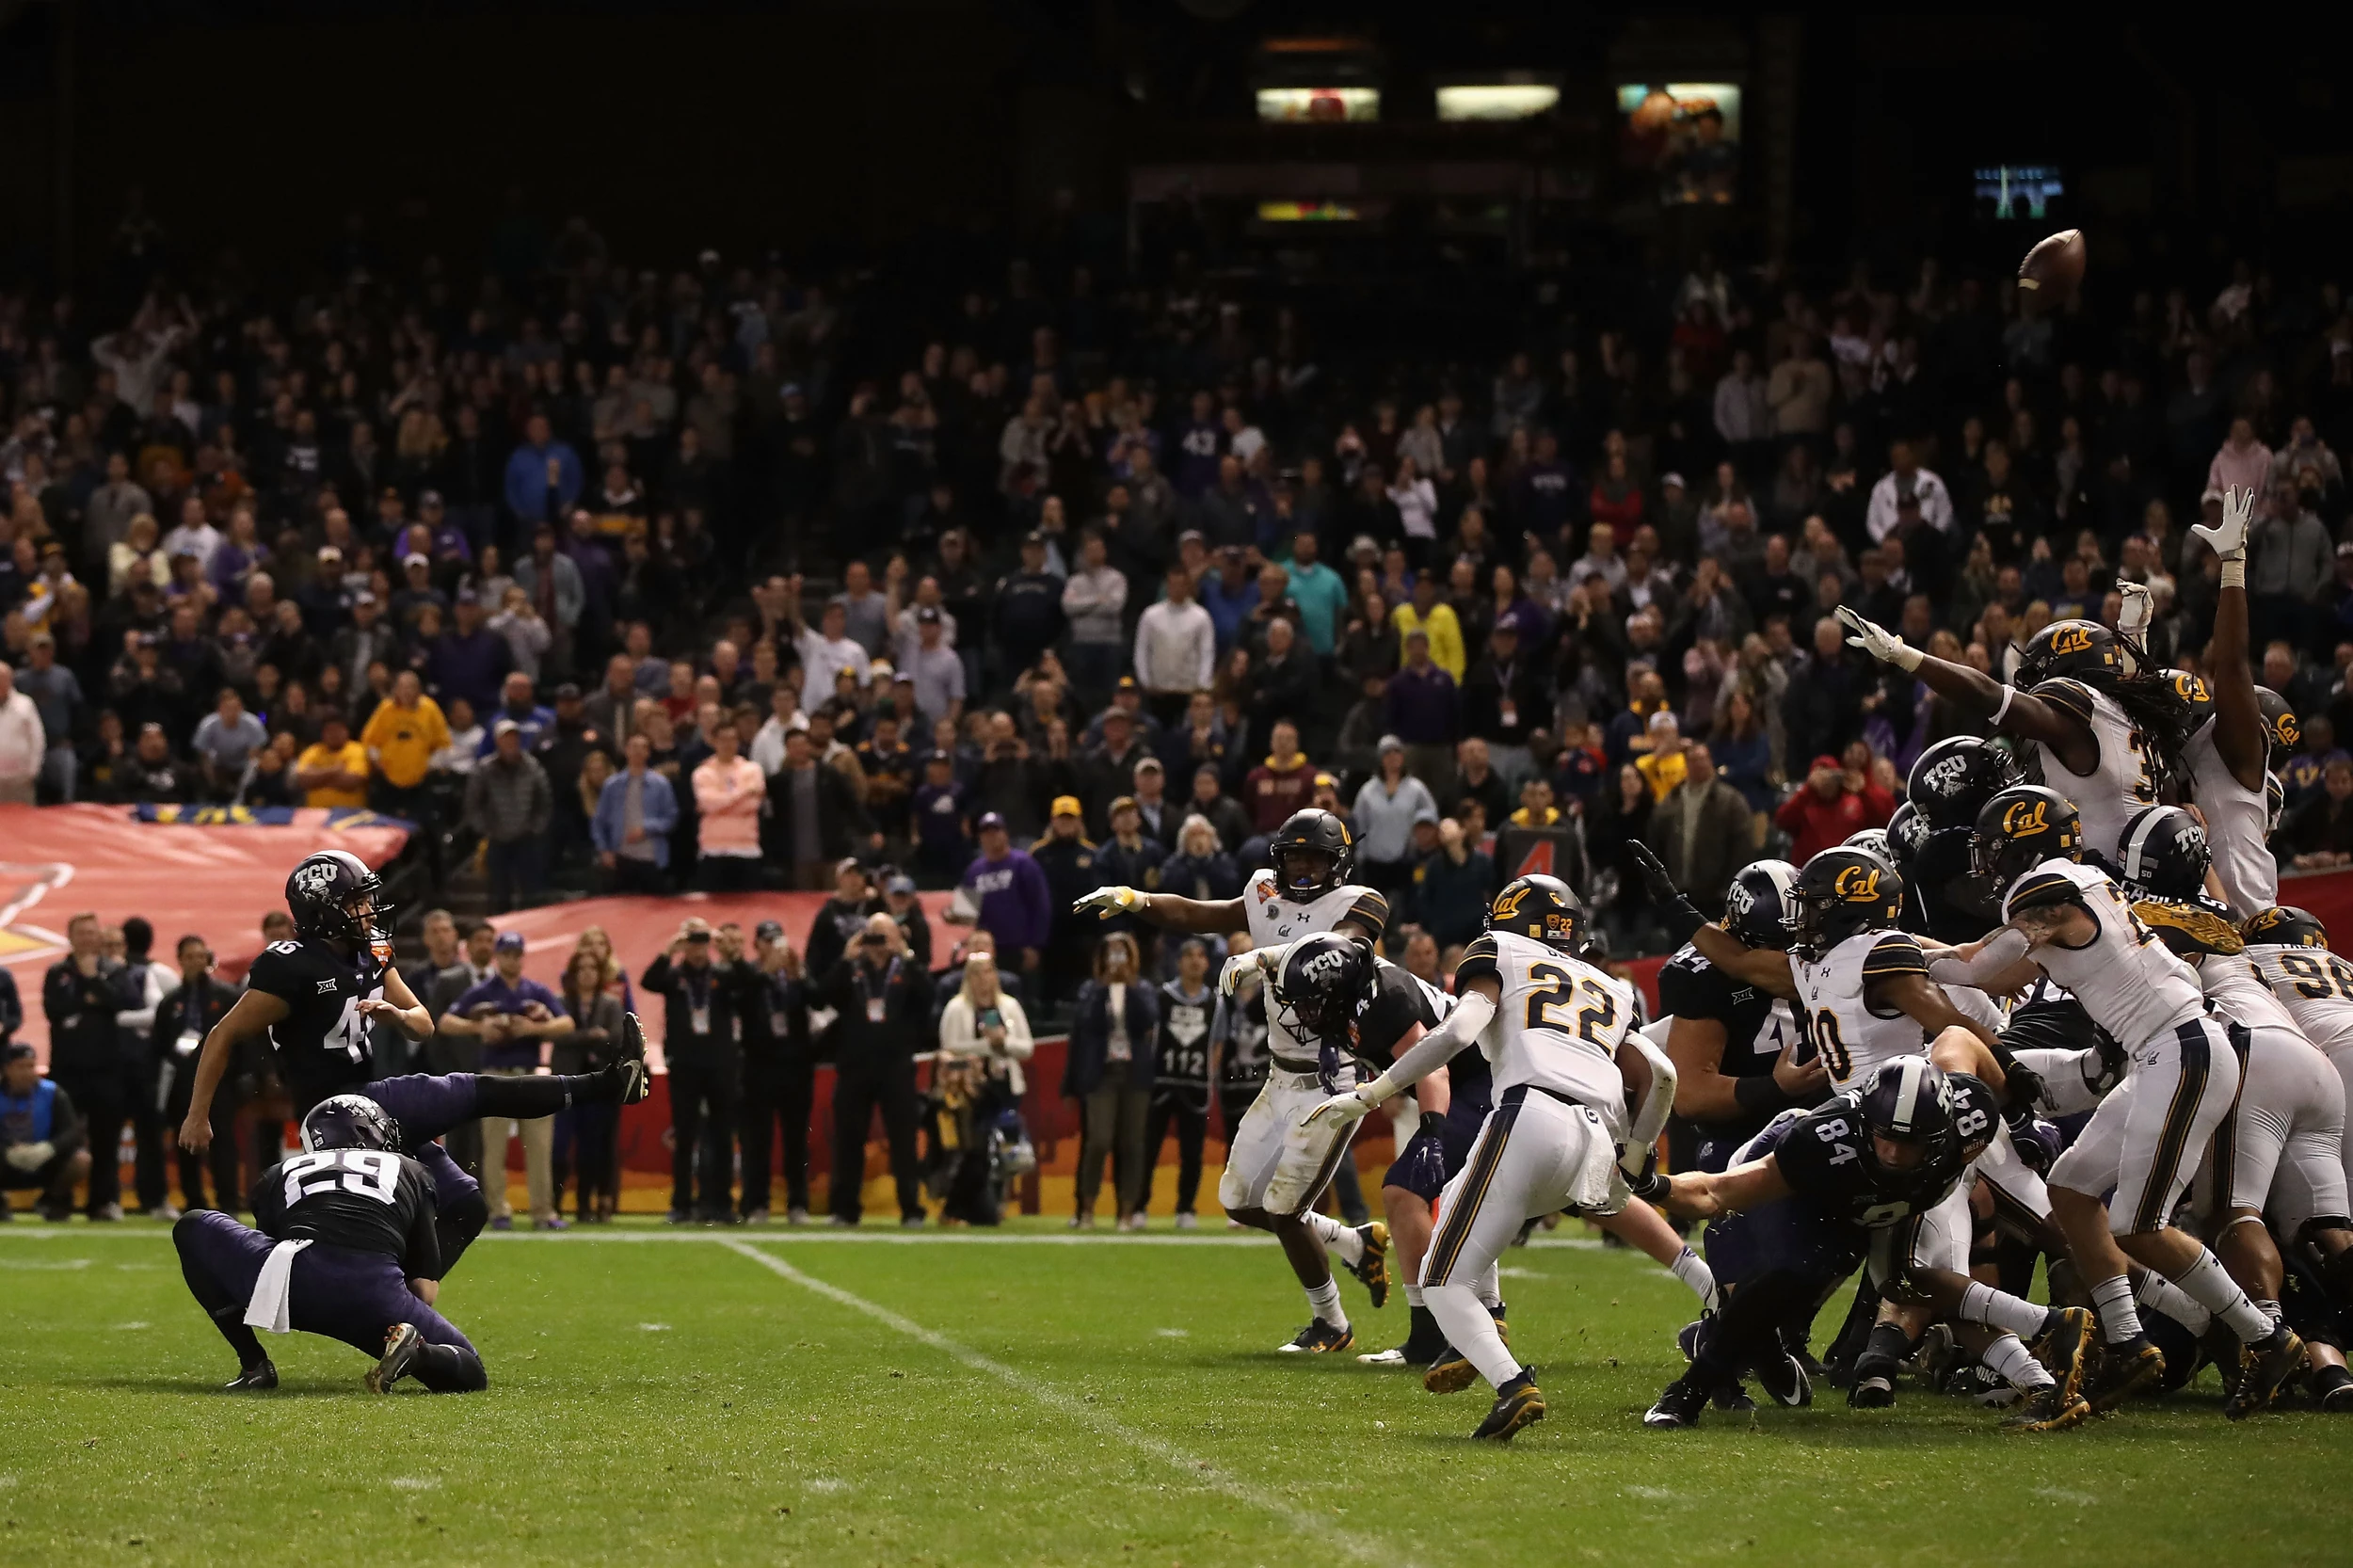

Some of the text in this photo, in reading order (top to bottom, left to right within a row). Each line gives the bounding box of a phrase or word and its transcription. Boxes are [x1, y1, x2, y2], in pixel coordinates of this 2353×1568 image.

[2276, 712, 2300, 745] Cal
[1922, 754, 1968, 792] TCU
[2002, 800, 2050, 839] Cal
[2174, 824, 2206, 854] TCU
[294, 863, 339, 892] TCU
[1834, 865, 1881, 903] Cal
[2140, 870, 2153, 879] 50
[1492, 885, 1532, 921] Cal
[1725, 879, 1755, 916] TCU
[1277, 924, 1292, 938] Cal
[1560, 918, 1573, 932] 22
[1301, 949, 1344, 984] TCU
[1524, 960, 1617, 1061] 22
[1163, 1048, 1205, 1076] 112
[1953, 1087, 1989, 1138] 84
[313, 1136, 325, 1148] 29
[1814, 1117, 1857, 1166] 84
[281, 1149, 402, 1209] 29
